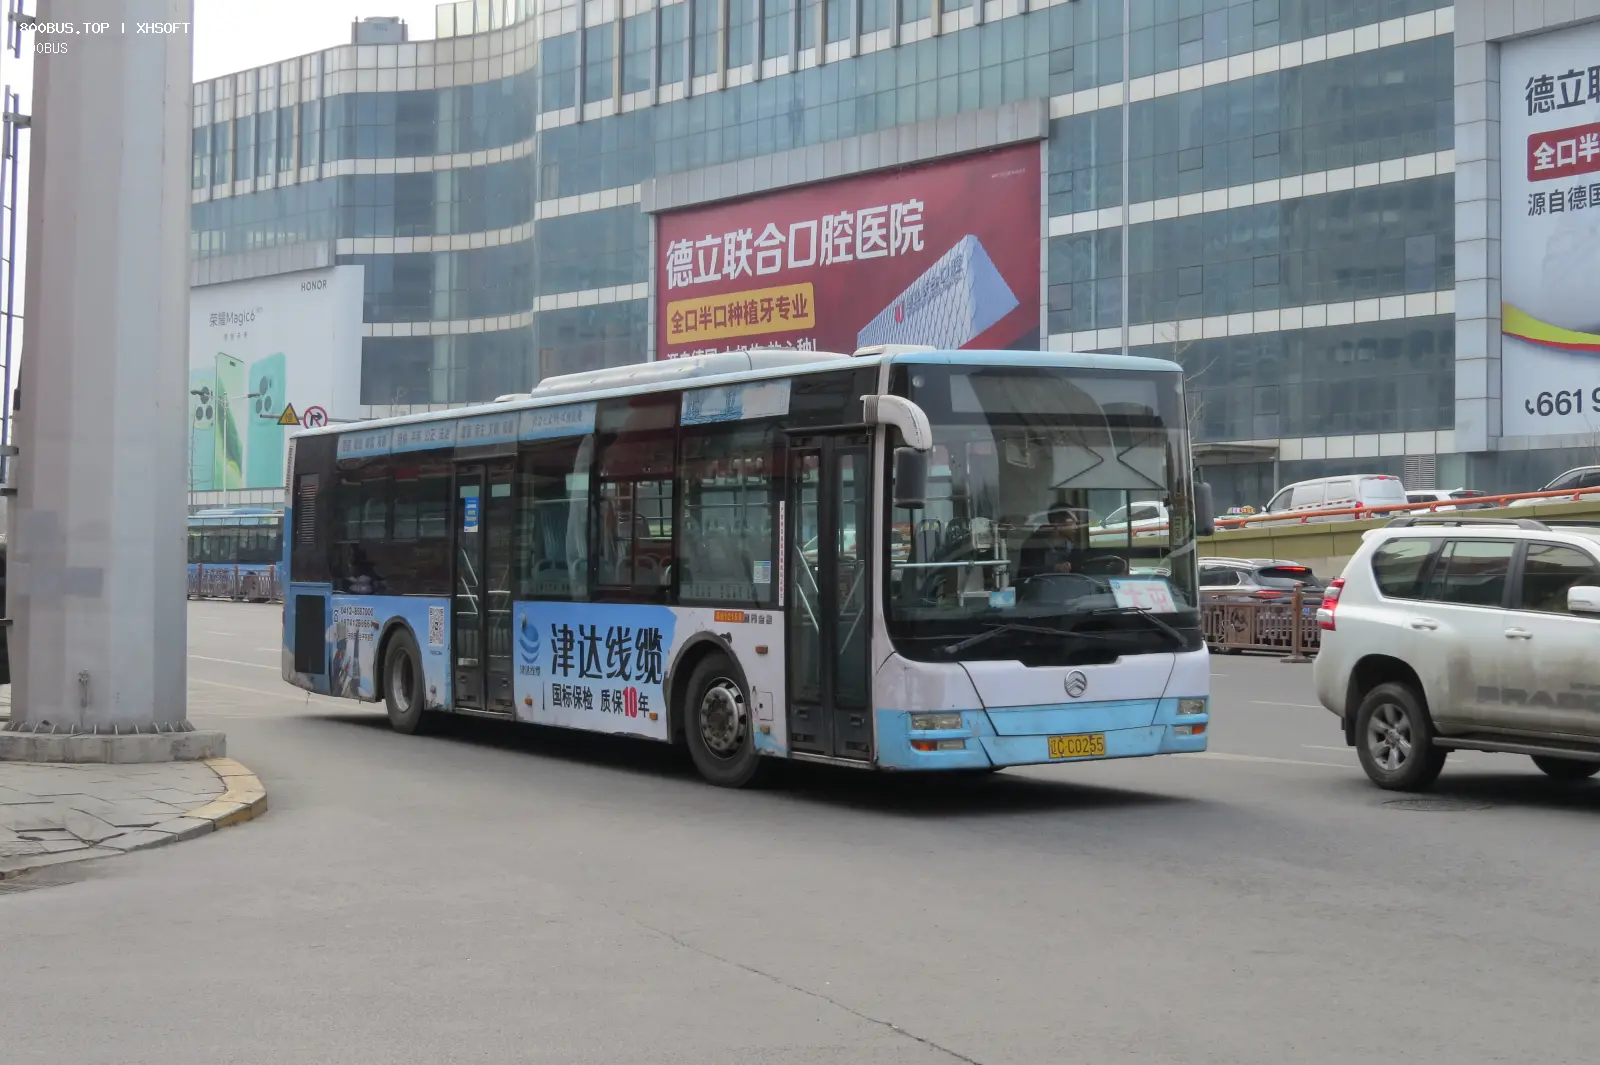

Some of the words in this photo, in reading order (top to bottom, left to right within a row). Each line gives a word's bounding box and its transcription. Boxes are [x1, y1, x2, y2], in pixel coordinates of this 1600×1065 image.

[1533, 133, 1600, 171] 全口半
[666, 198, 924, 290] 德立联合口腔医院
[301, 279, 327, 292] HONOR
[671, 292, 809, 335] 全口半口种植牙专业
[551, 623, 663, 685] 津达线缆
[552, 683, 593, 711] 国标保检
[600, 686, 650, 718] 质保10年
